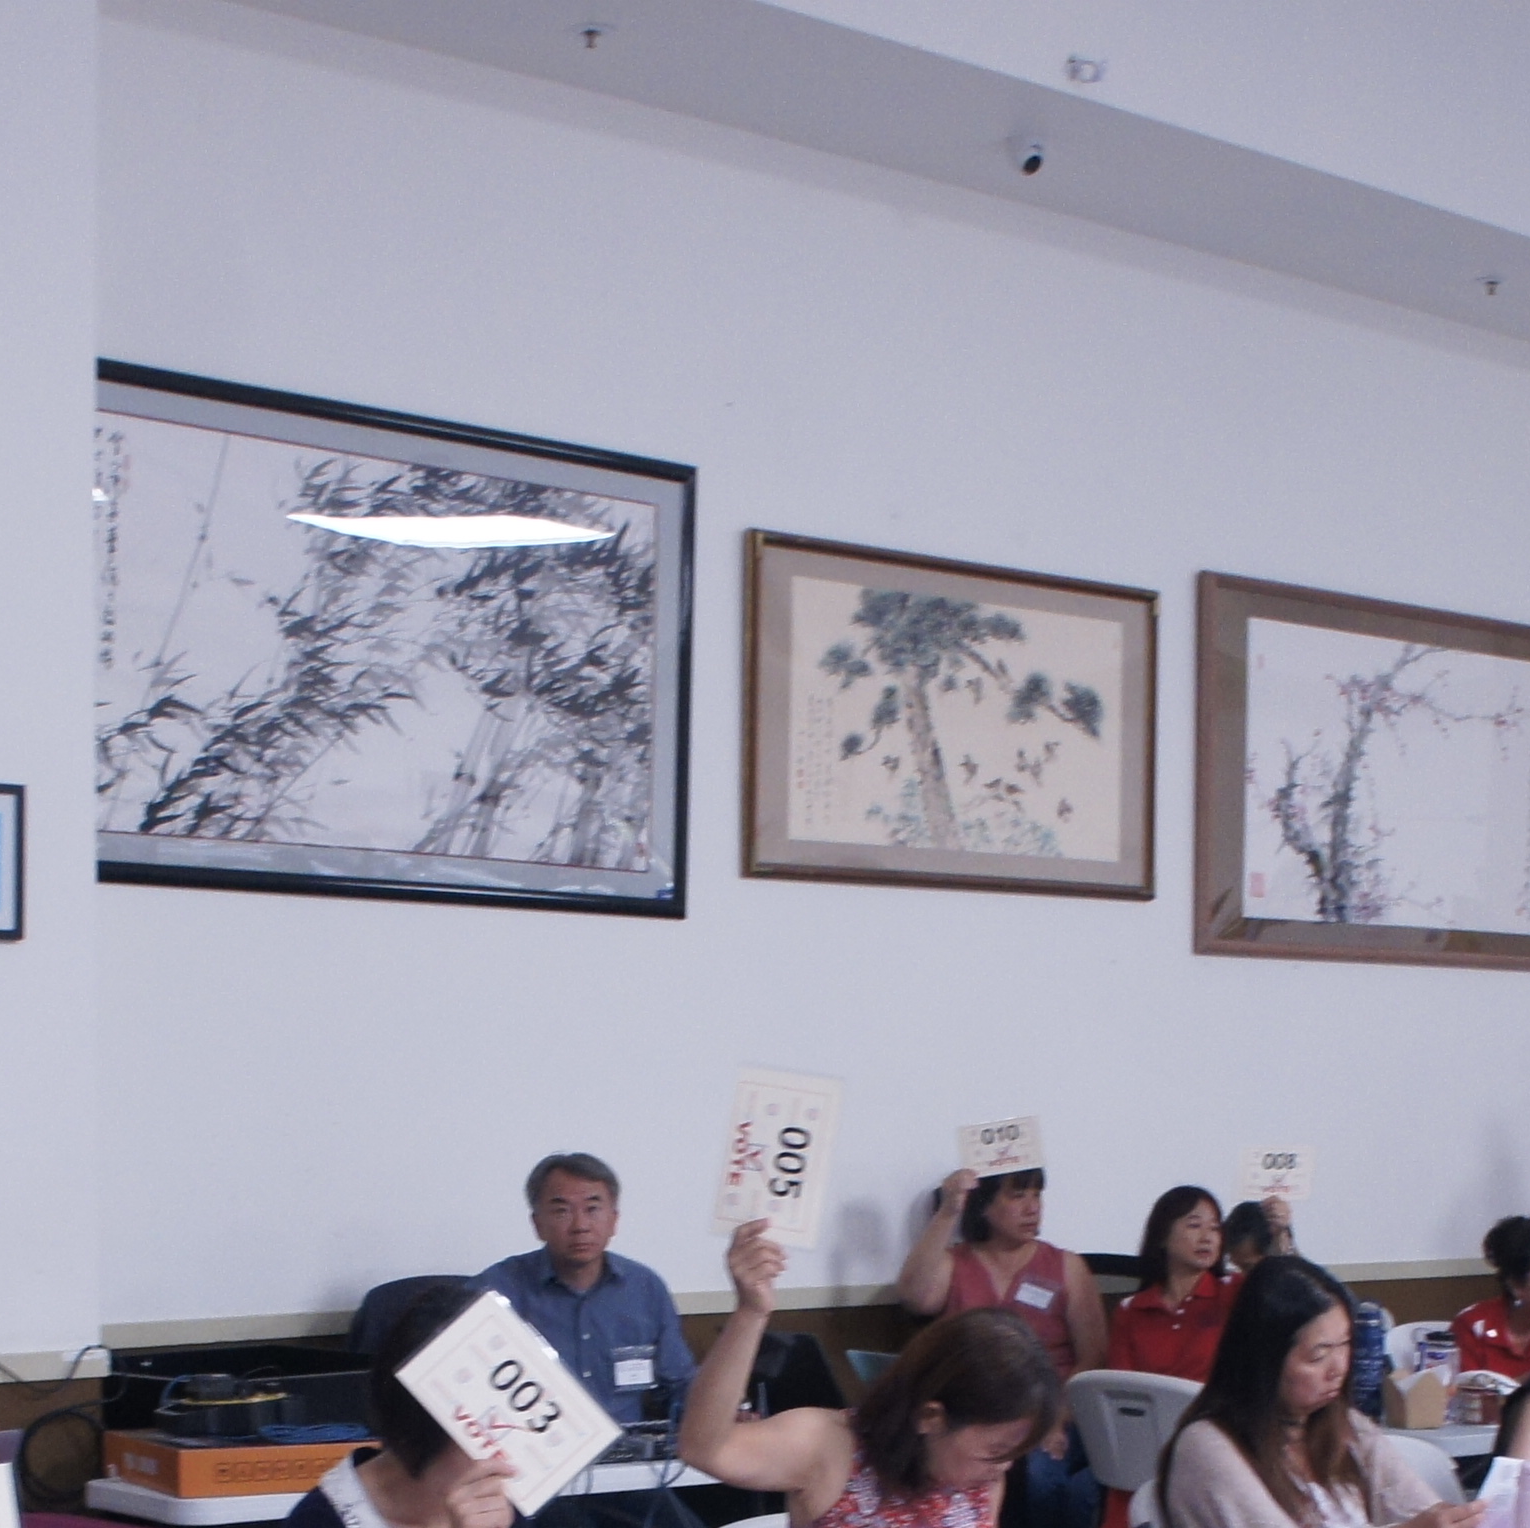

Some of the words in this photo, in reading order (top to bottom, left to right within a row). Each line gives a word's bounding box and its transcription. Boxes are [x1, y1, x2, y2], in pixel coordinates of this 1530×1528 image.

[726, 1121, 754, 1186] VOTE
[768, 1126, 811, 1198] 005
[980, 1124, 1020, 1145] 010
[1261, 1153, 1297, 1170] 008
[489, 1359, 562, 1433] 003
